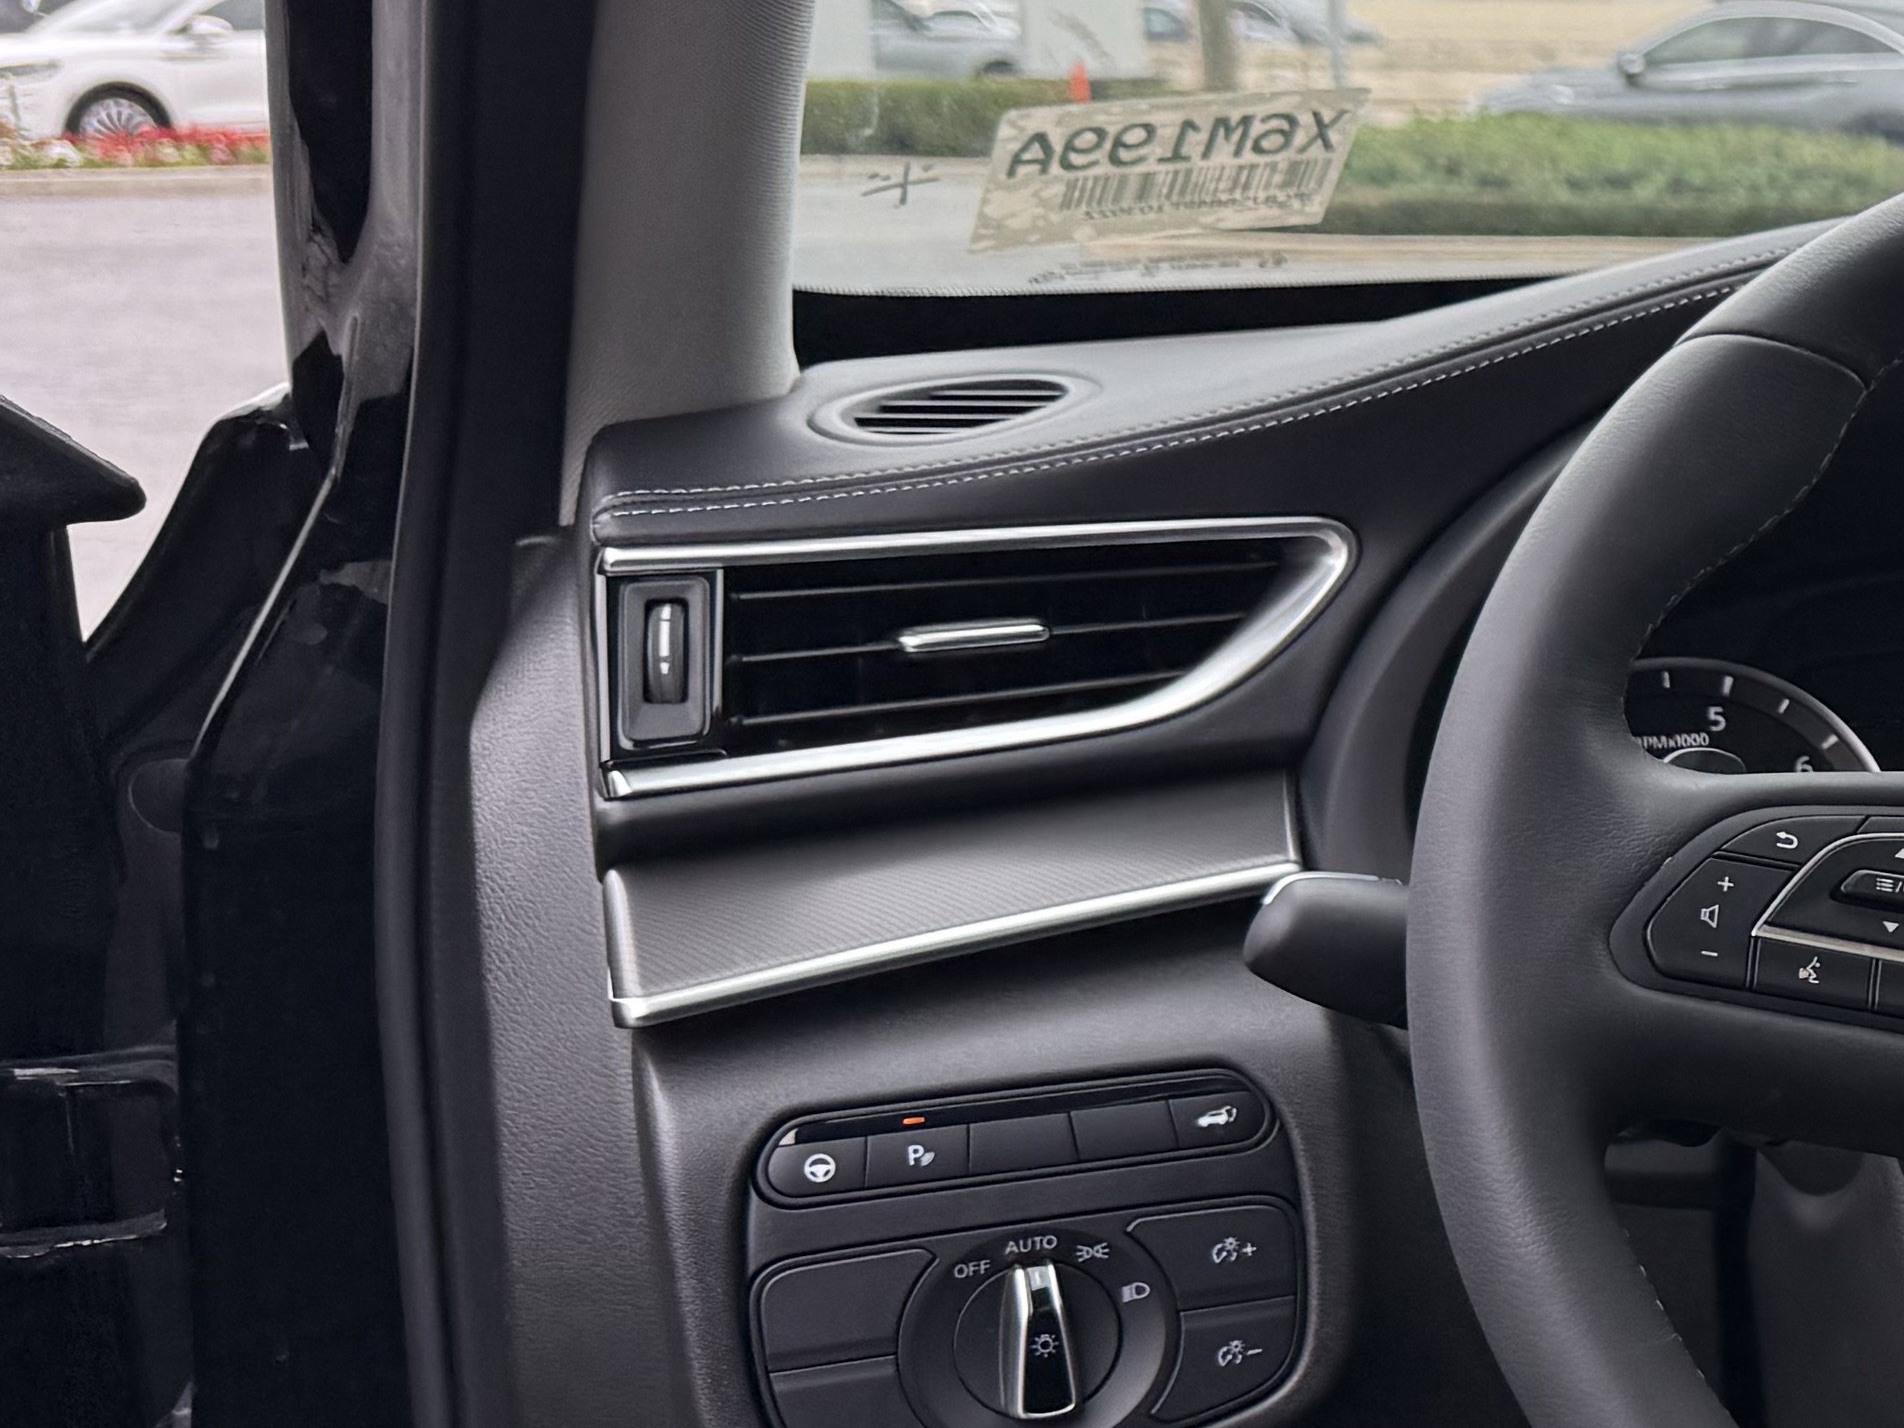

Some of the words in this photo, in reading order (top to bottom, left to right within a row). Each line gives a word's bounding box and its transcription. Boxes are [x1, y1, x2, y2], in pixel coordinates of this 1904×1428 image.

[1706, 706, 1727, 732] 5
[1637, 732, 1709, 750] PMx1000
[1795, 756, 1813, 772] 6
[1005, 1234, 1057, 1256] AUTO
[954, 1259, 990, 1279] OFF
